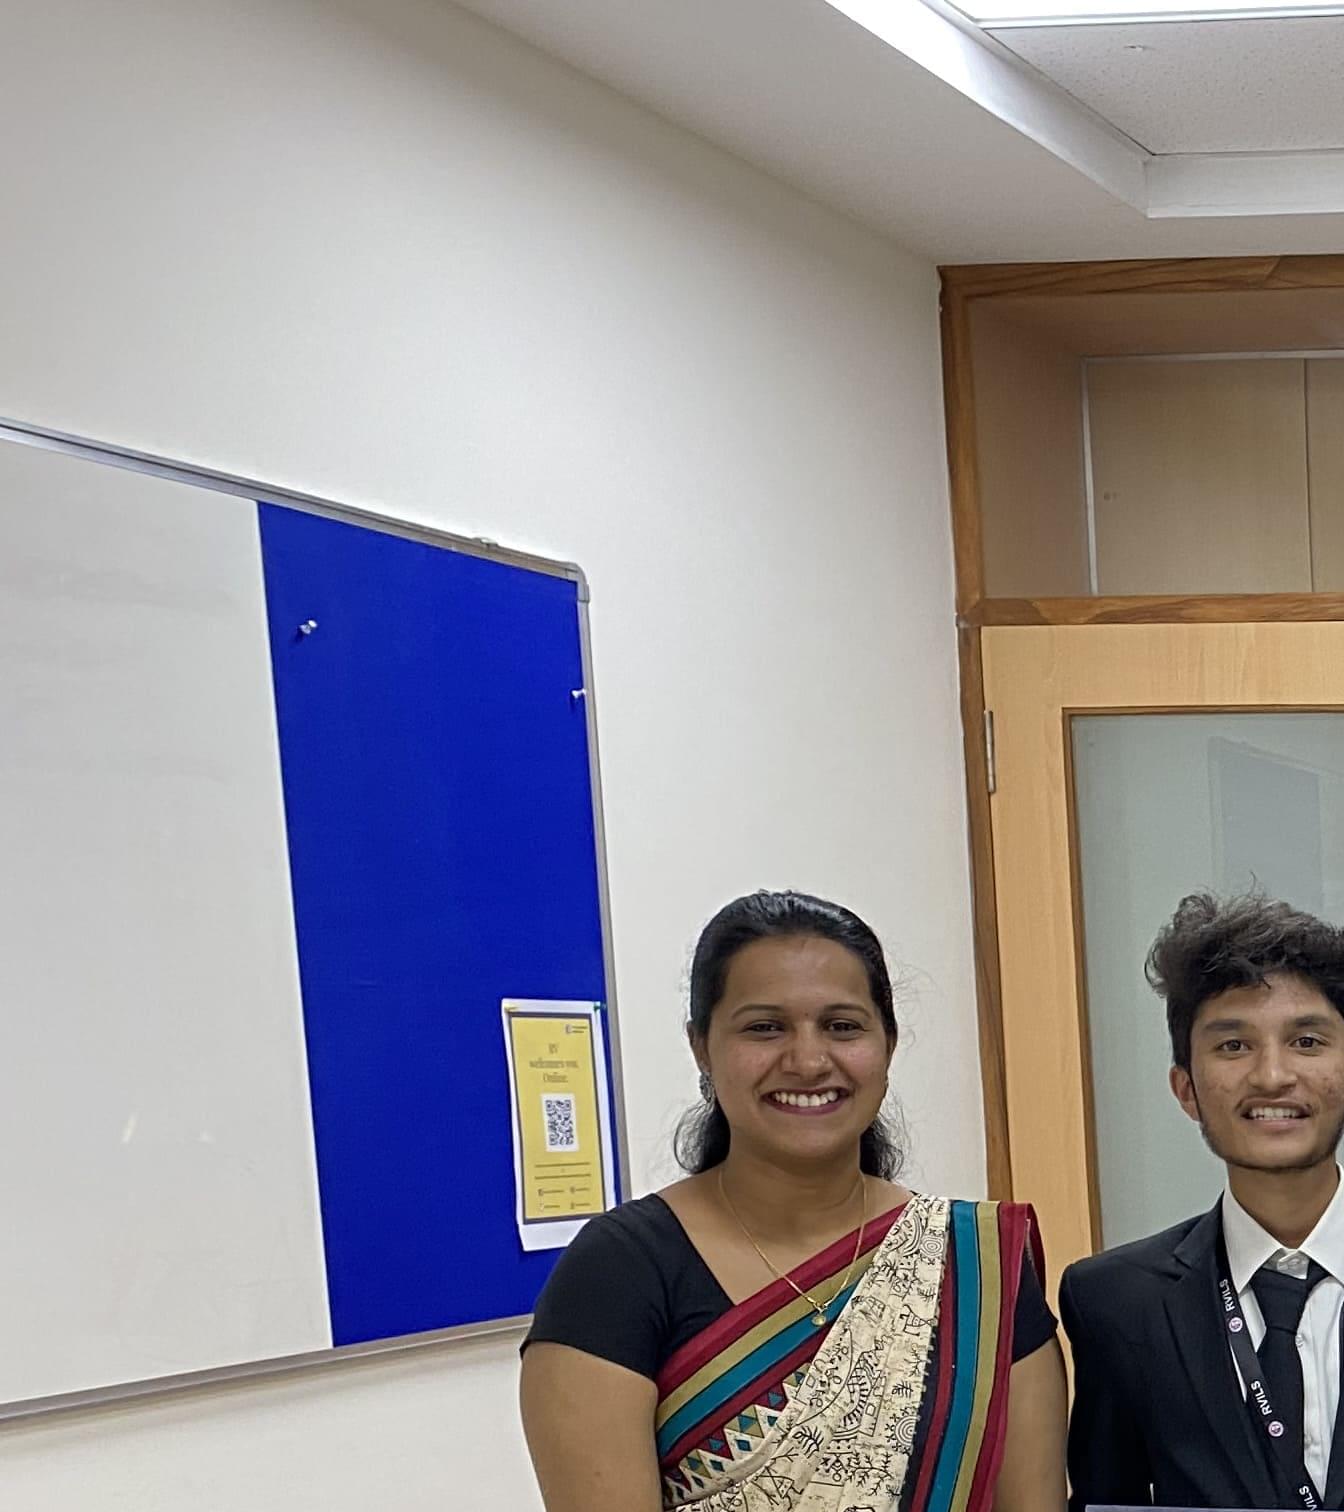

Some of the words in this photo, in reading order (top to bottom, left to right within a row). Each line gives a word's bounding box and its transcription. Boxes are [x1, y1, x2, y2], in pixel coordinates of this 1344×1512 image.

[1219, 1278, 1235, 1312] RVILS
[1250, 1380, 1273, 1416] RVILS
[1298, 1485, 1318, 1511] VILS
